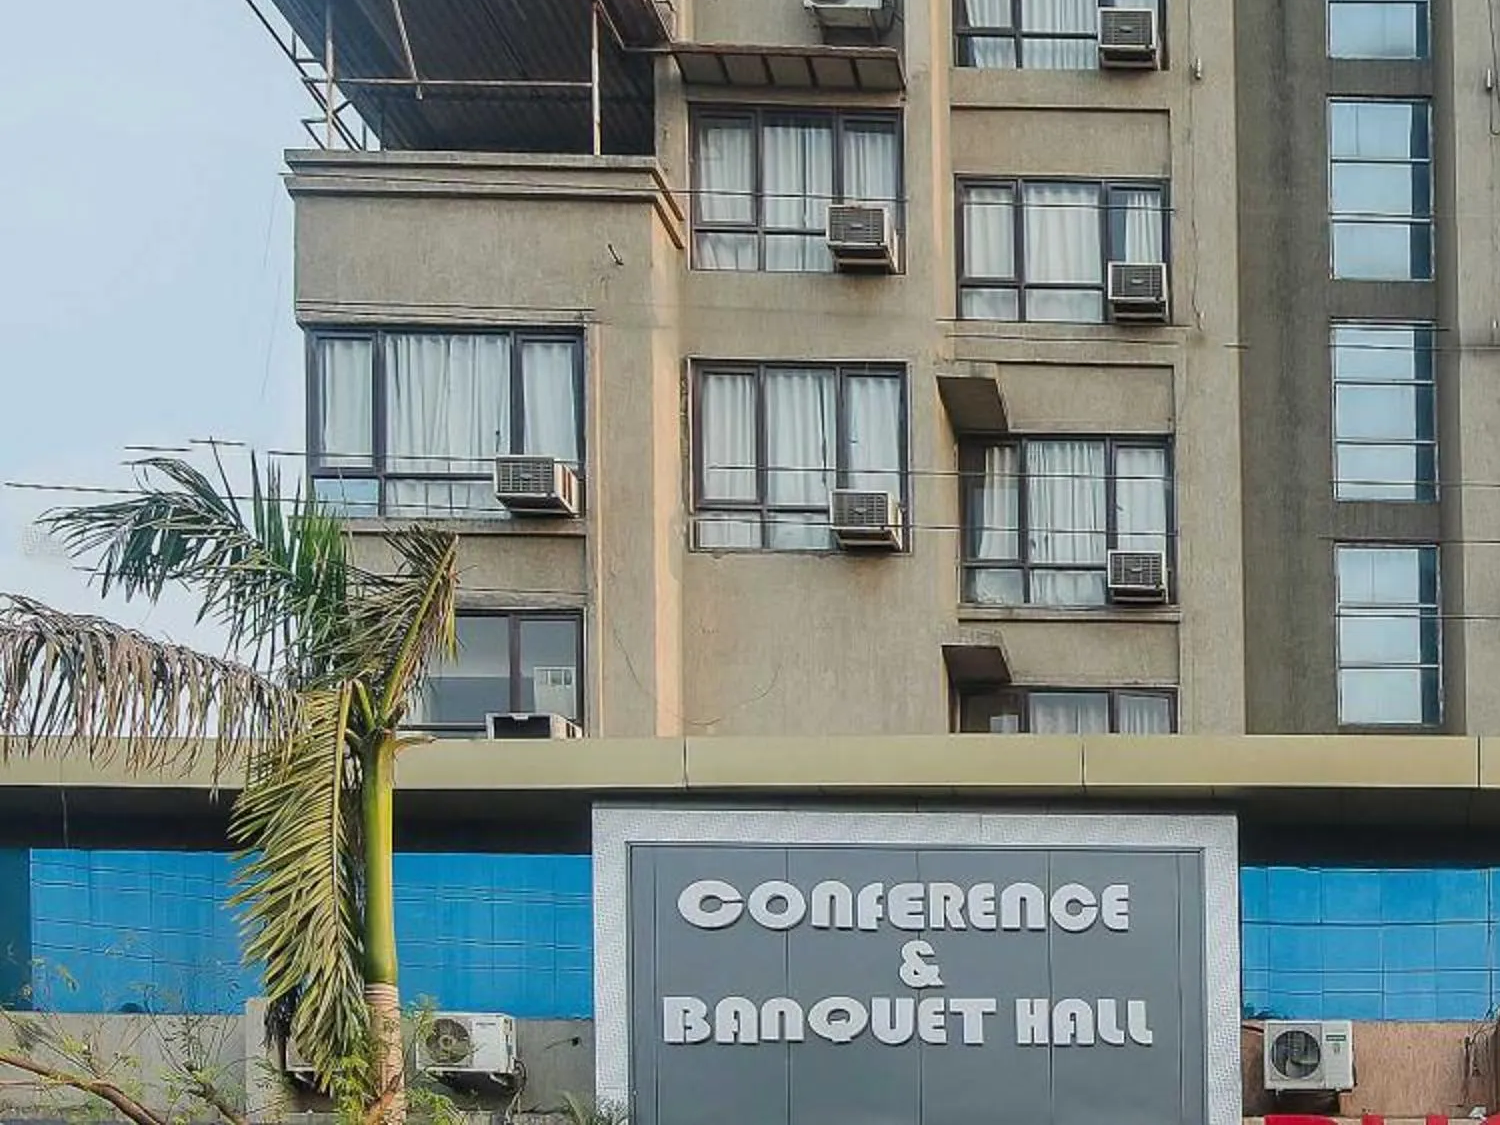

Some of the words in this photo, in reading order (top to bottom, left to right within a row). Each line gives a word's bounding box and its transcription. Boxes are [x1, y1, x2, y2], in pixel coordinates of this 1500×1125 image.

[677, 879, 1131, 932] CONFERENCE
[898, 940, 944, 988] &
[662, 996, 997, 1046] BANQUET
[1016, 997, 1154, 1046] HALL
